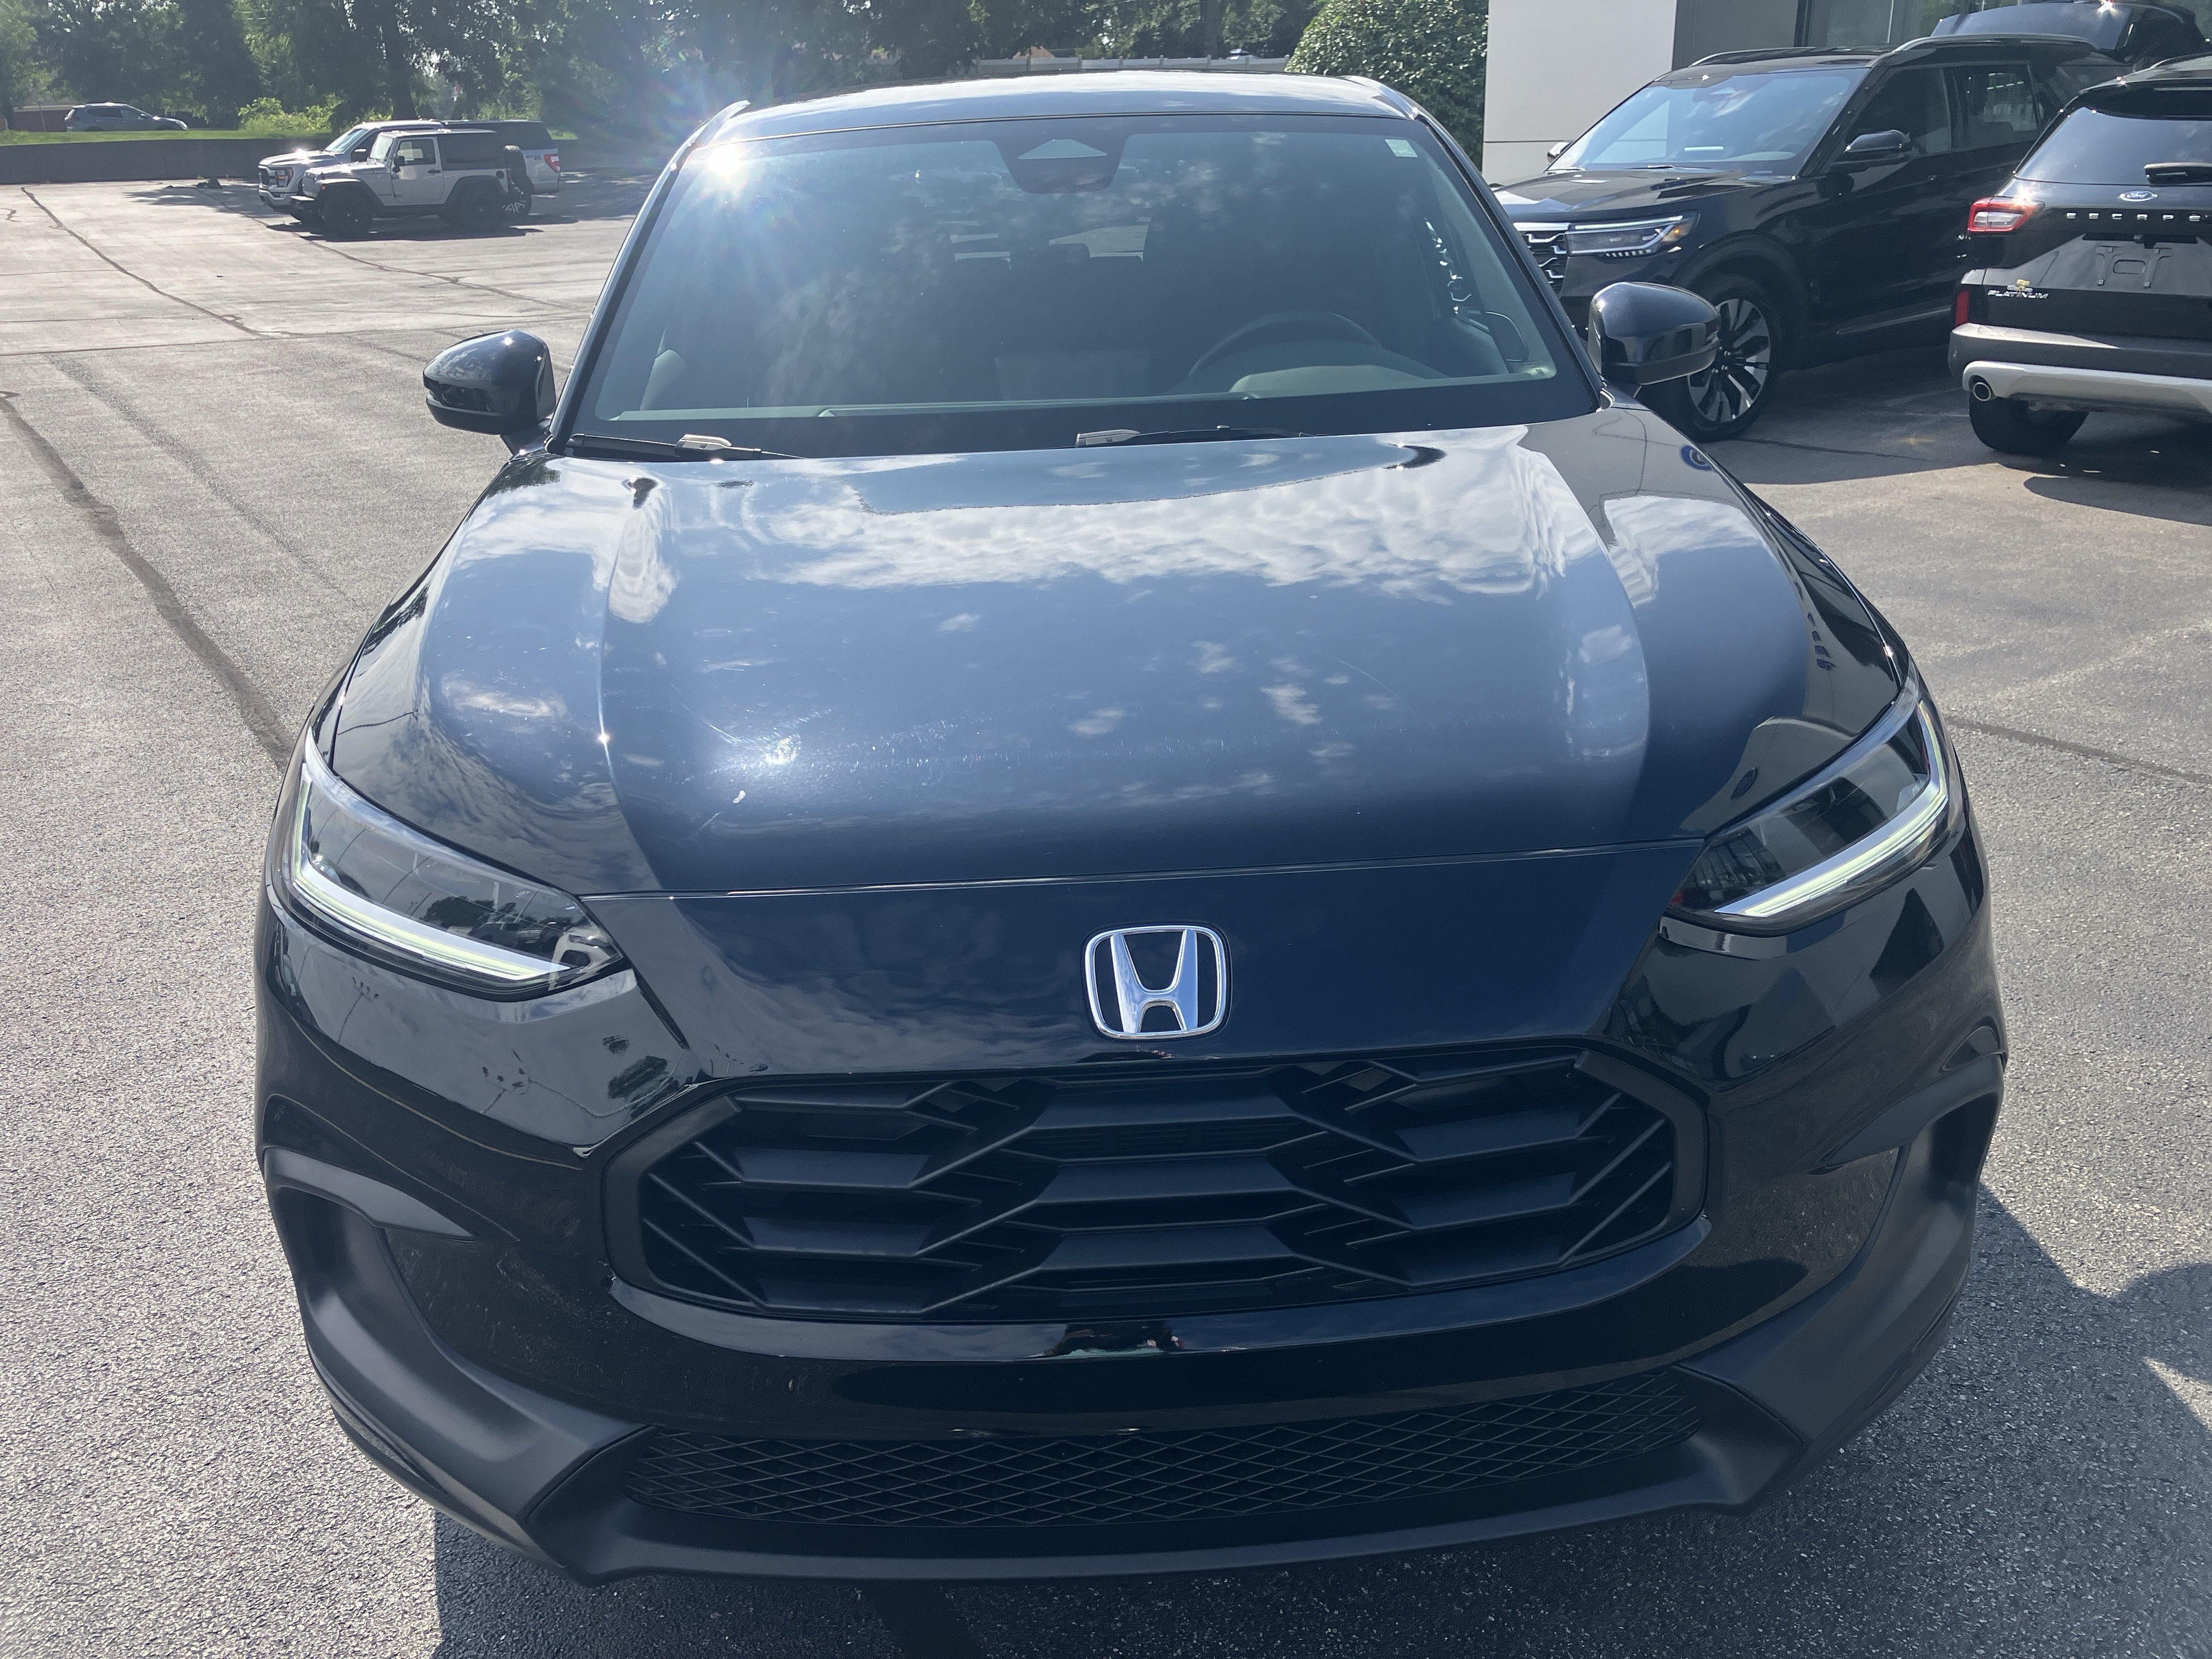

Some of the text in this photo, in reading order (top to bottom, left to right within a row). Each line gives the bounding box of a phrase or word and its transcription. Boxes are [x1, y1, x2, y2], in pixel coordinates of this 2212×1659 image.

[2067, 212, 2201, 222] ESCAPE
[1987, 290, 2049, 299] PLATINUM
[1110, 928, 1198, 1034] H
